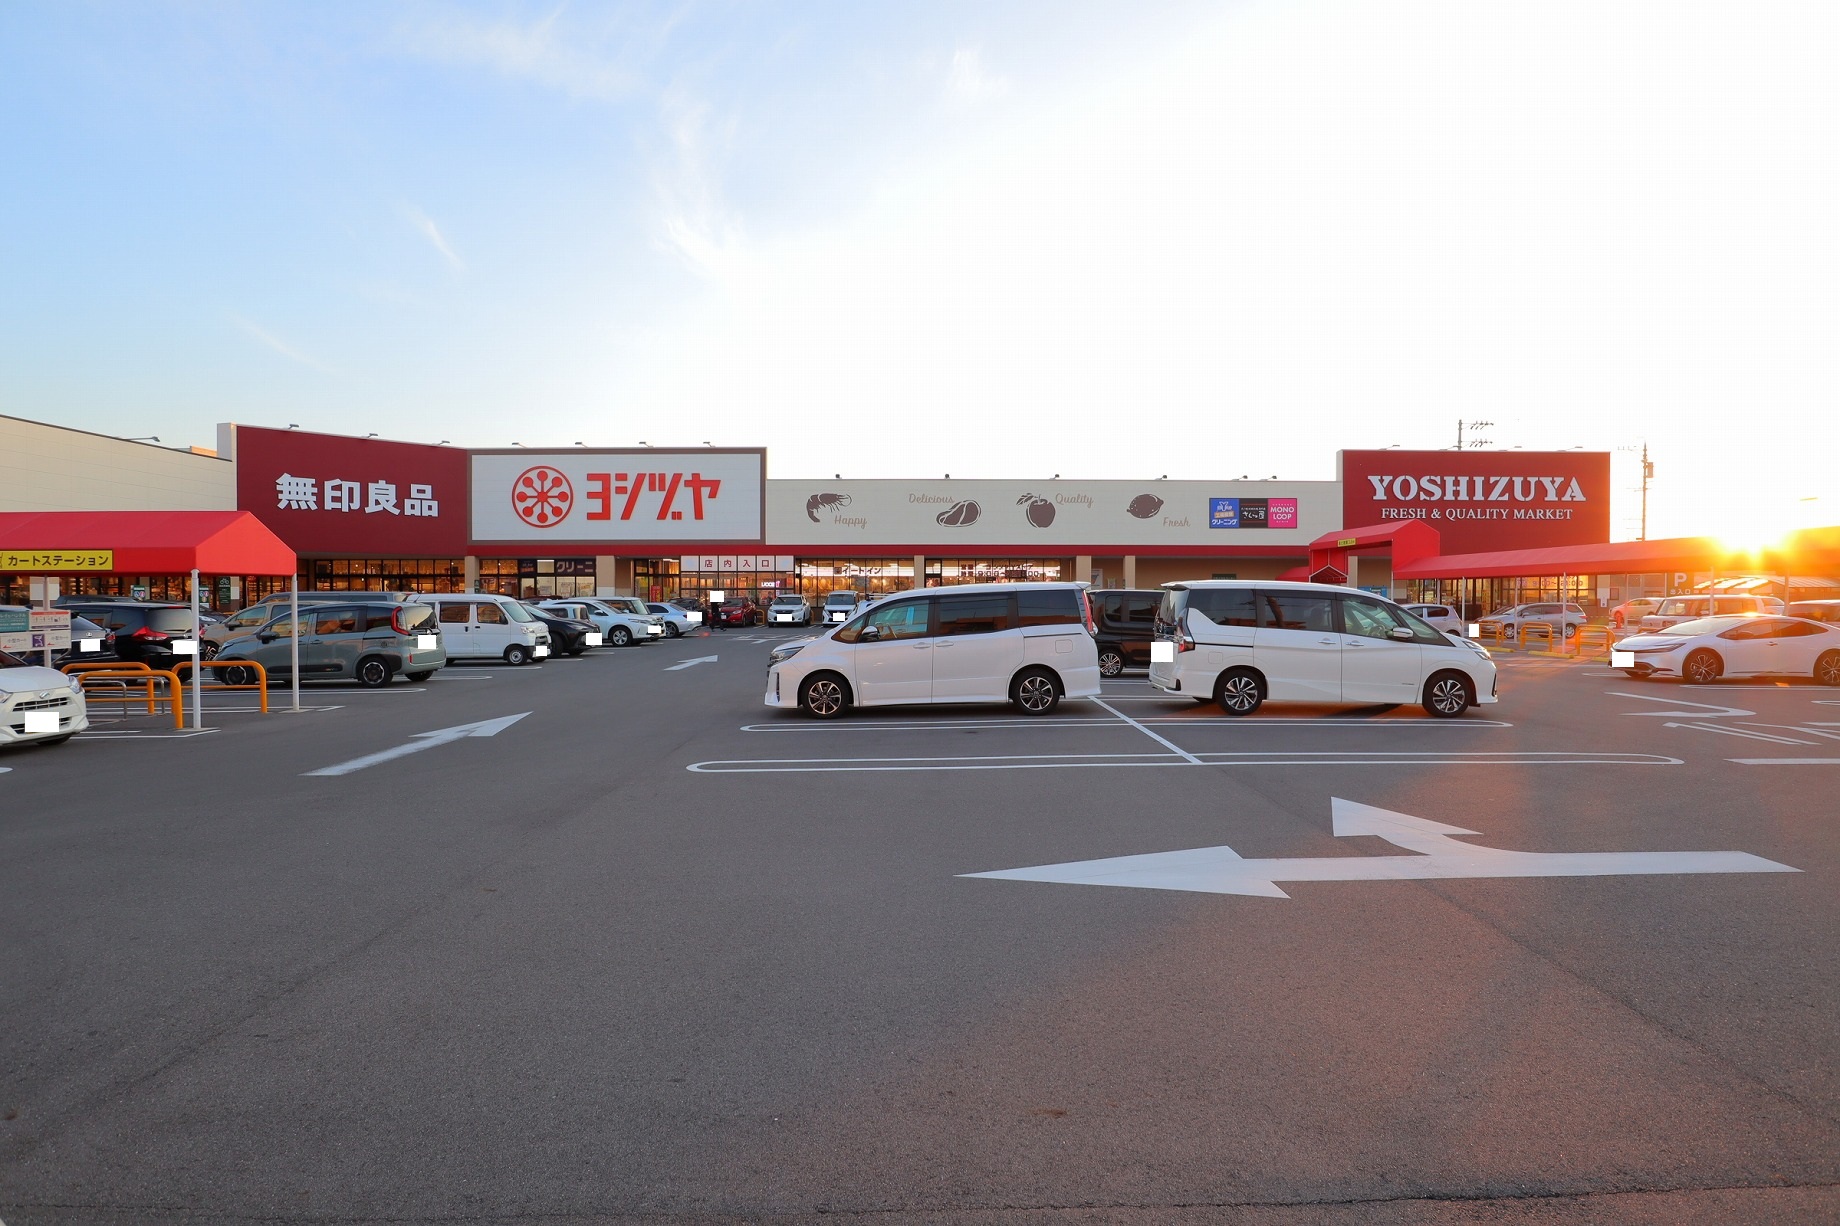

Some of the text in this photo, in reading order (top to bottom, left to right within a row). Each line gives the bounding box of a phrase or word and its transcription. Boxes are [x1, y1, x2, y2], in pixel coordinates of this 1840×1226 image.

[276, 472, 439, 517] 無印良品
[1367, 475, 1587, 502] YOSHIZUYA
[586, 473, 721, 520] ヨシヅヤ
[908, 493, 955, 504] Delicious
[1055, 492, 1094, 508] Quality
[834, 514, 867, 529] Happy
[1381, 508, 1573, 521] FRESH & QUALITY MARKET
[1162, 516, 1191, 528] Fresh
[8, 555, 109, 567] カートステーション
[704, 559, 770, 568] 店内入口
[842, 564, 882, 575] イートイン
[1674, 572, 1687, 587] P
